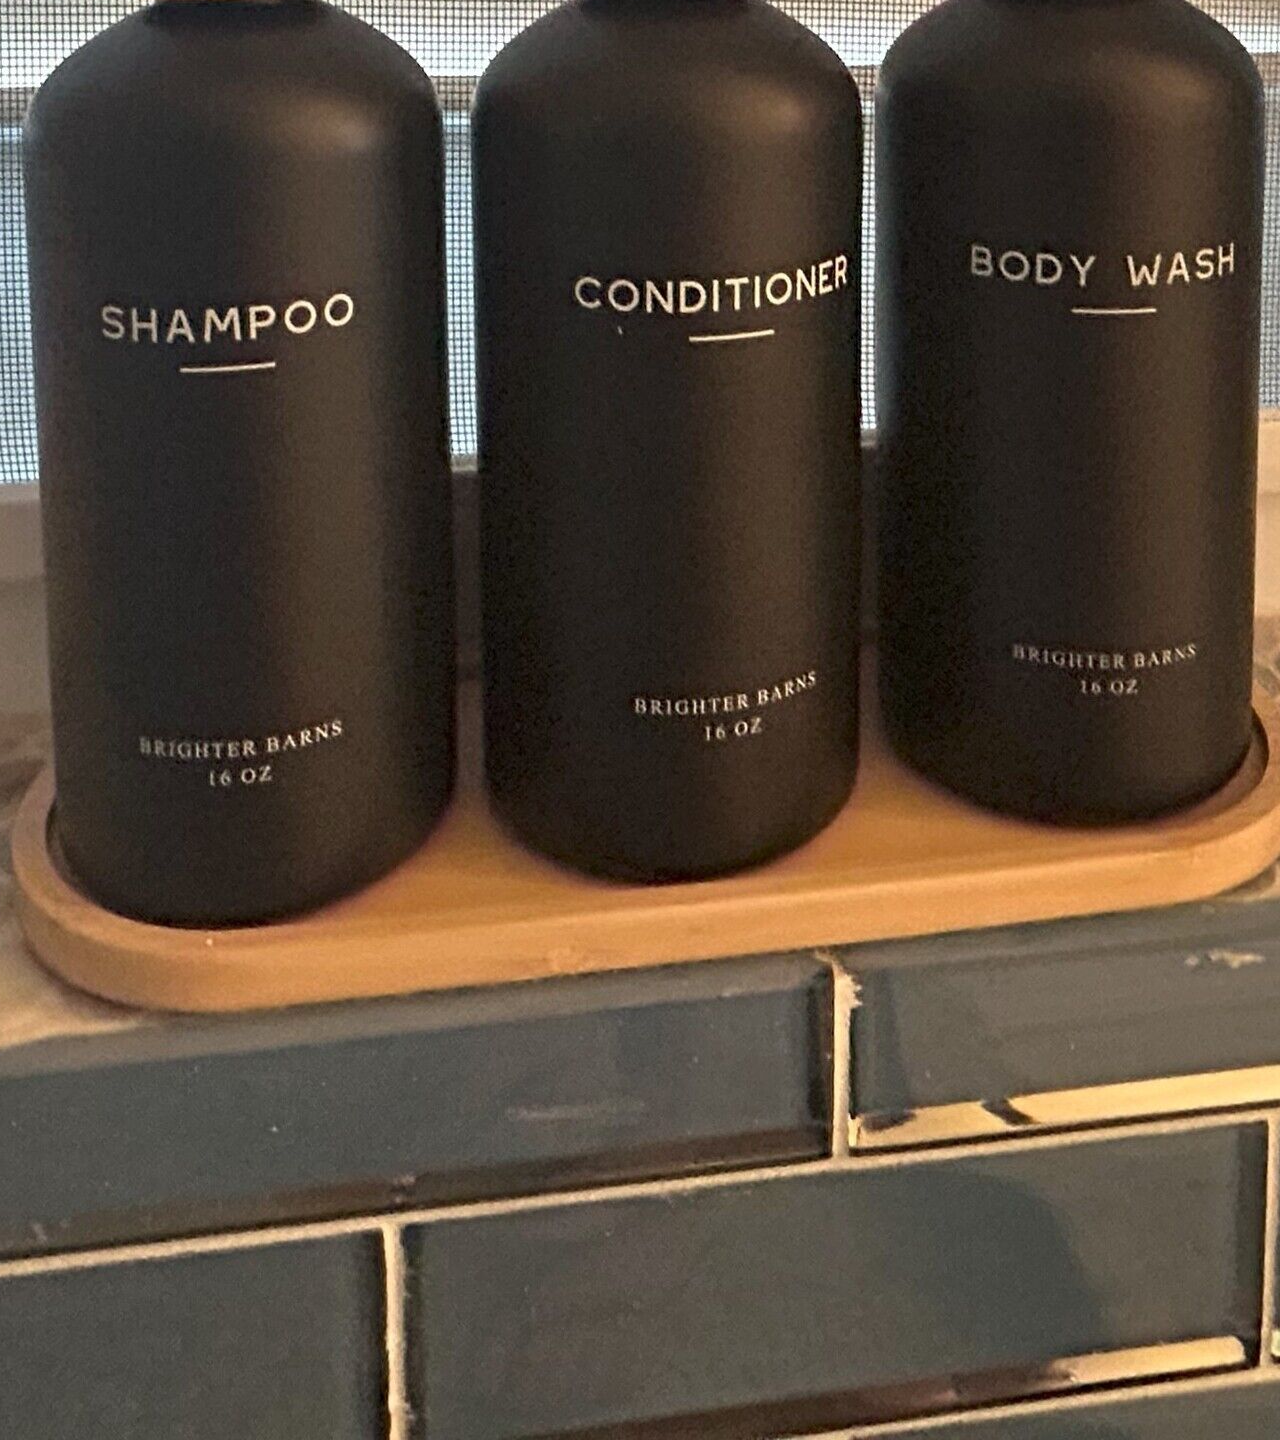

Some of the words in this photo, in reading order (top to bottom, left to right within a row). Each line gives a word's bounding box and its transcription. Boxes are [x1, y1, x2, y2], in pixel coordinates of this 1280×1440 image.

[574, 254, 849, 314] CONDITIONER
[971, 242, 1096, 287] BODY
[1127, 242, 1234, 287] WASH
[101, 293, 354, 343] SHAMPOO
[1013, 643, 1125, 670] BRIGHTER
[1134, 643, 1197, 668] BARNS
[634, 694, 749, 715] BRIGHTER
[757, 671, 816, 705] BARNS
[1081, 680, 1101, 695] 16
[1110, 679, 1139, 695] OZ
[139, 736, 257, 758] BRIGHTER
[267, 719, 343, 753] BARNS
[705, 725, 726, 741] 16
[734, 717, 762, 737] OZ
[209, 768, 231, 786] 16
[241, 765, 273, 784] OZ
